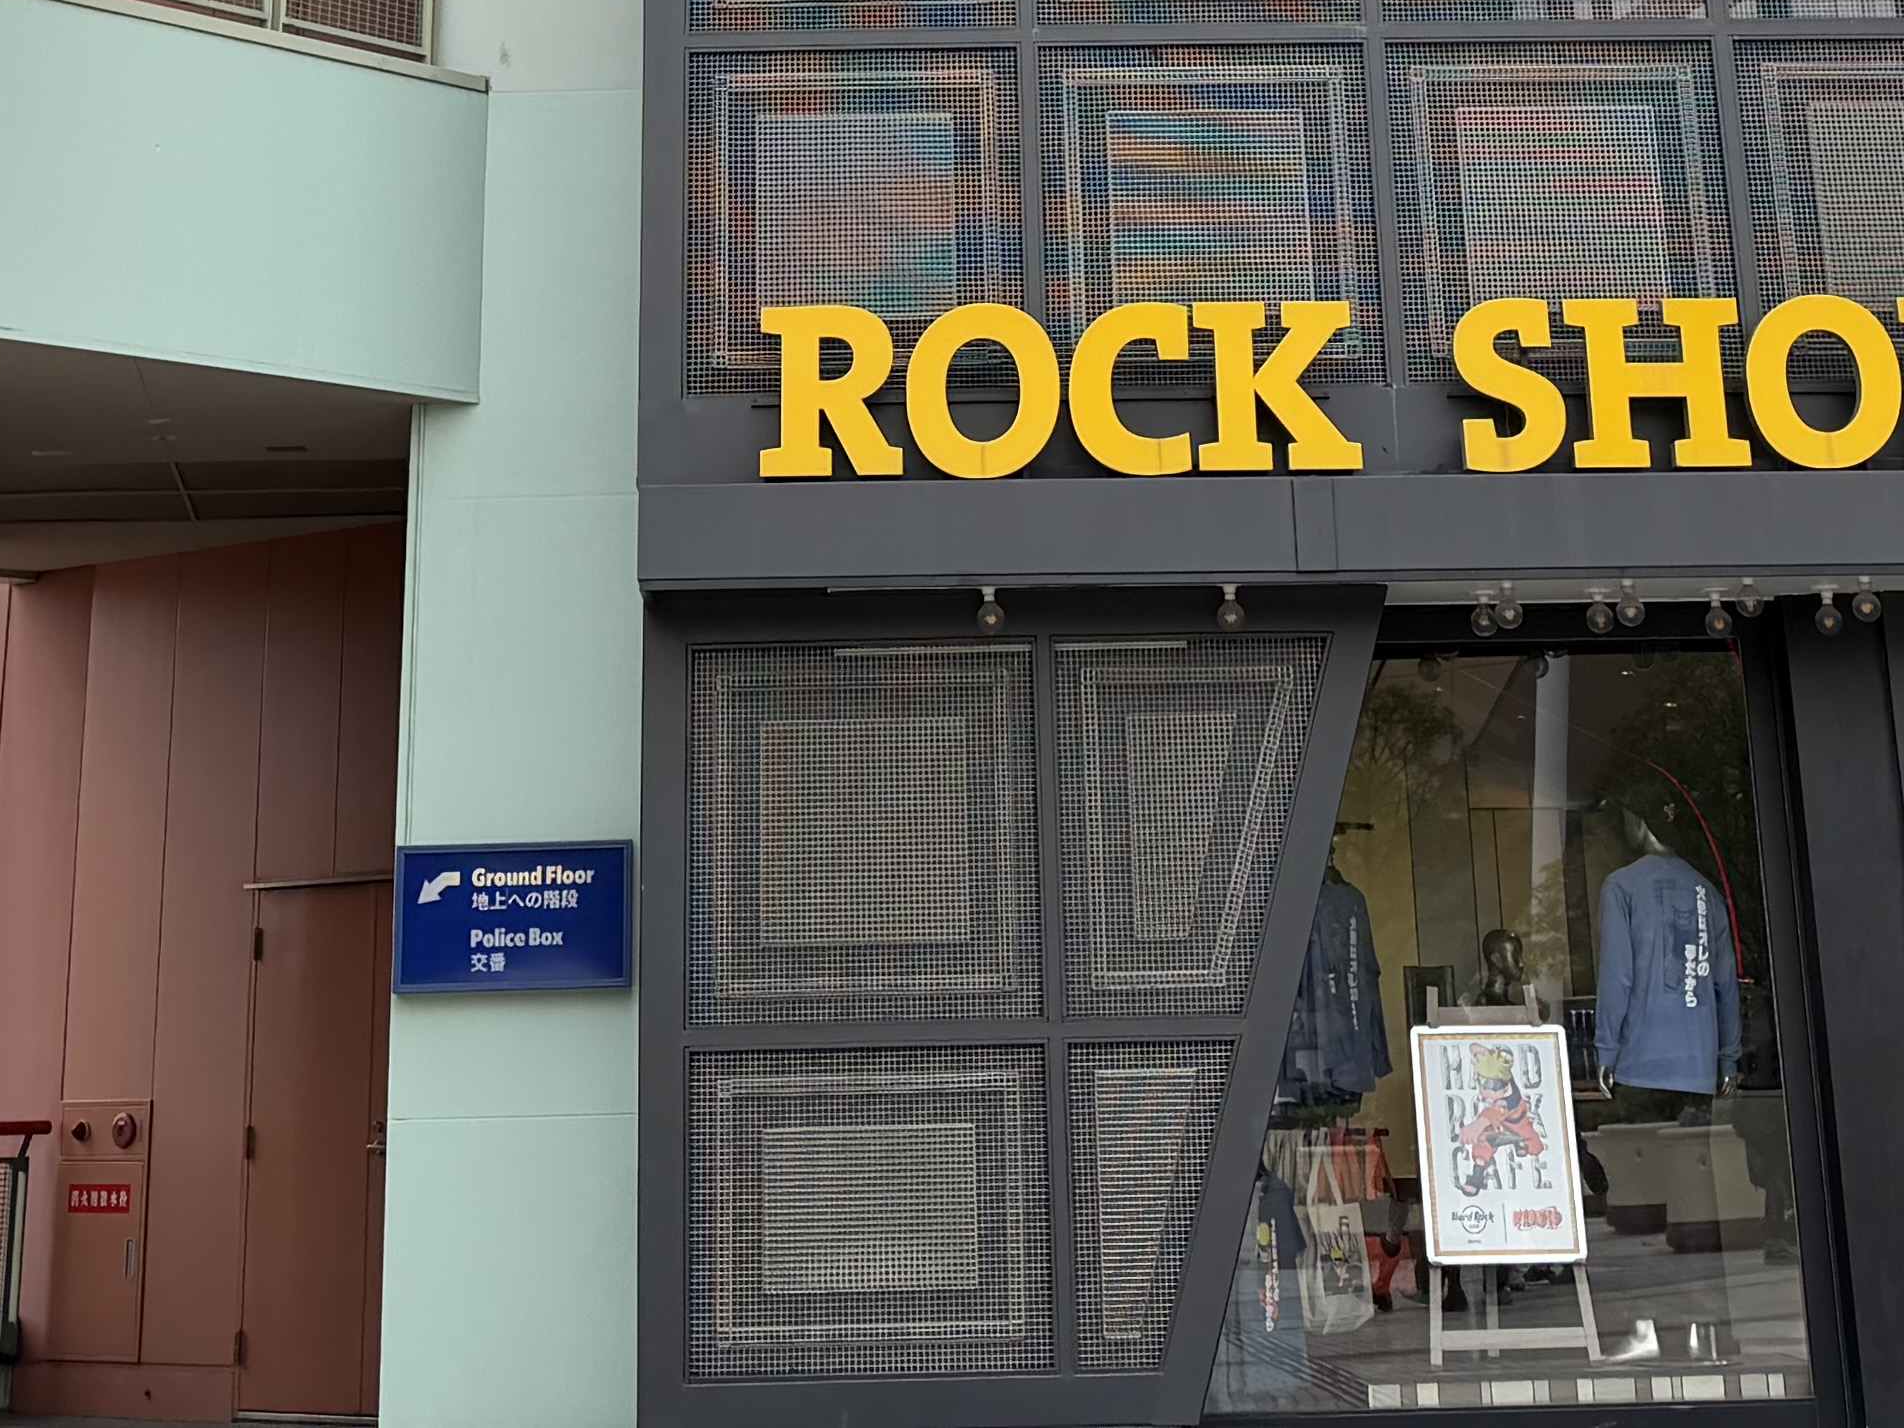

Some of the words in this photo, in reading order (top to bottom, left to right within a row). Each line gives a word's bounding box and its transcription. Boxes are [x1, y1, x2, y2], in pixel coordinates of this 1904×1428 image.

[758, 300, 1364, 480] ROCK
[471, 865, 543, 887] Ground
[545, 864, 596, 885] Floor
[471, 889, 579, 911] 地上への階段
[470, 927, 526, 948] Police
[528, 927, 564, 946] Box
[470, 952, 506, 973] 交番
